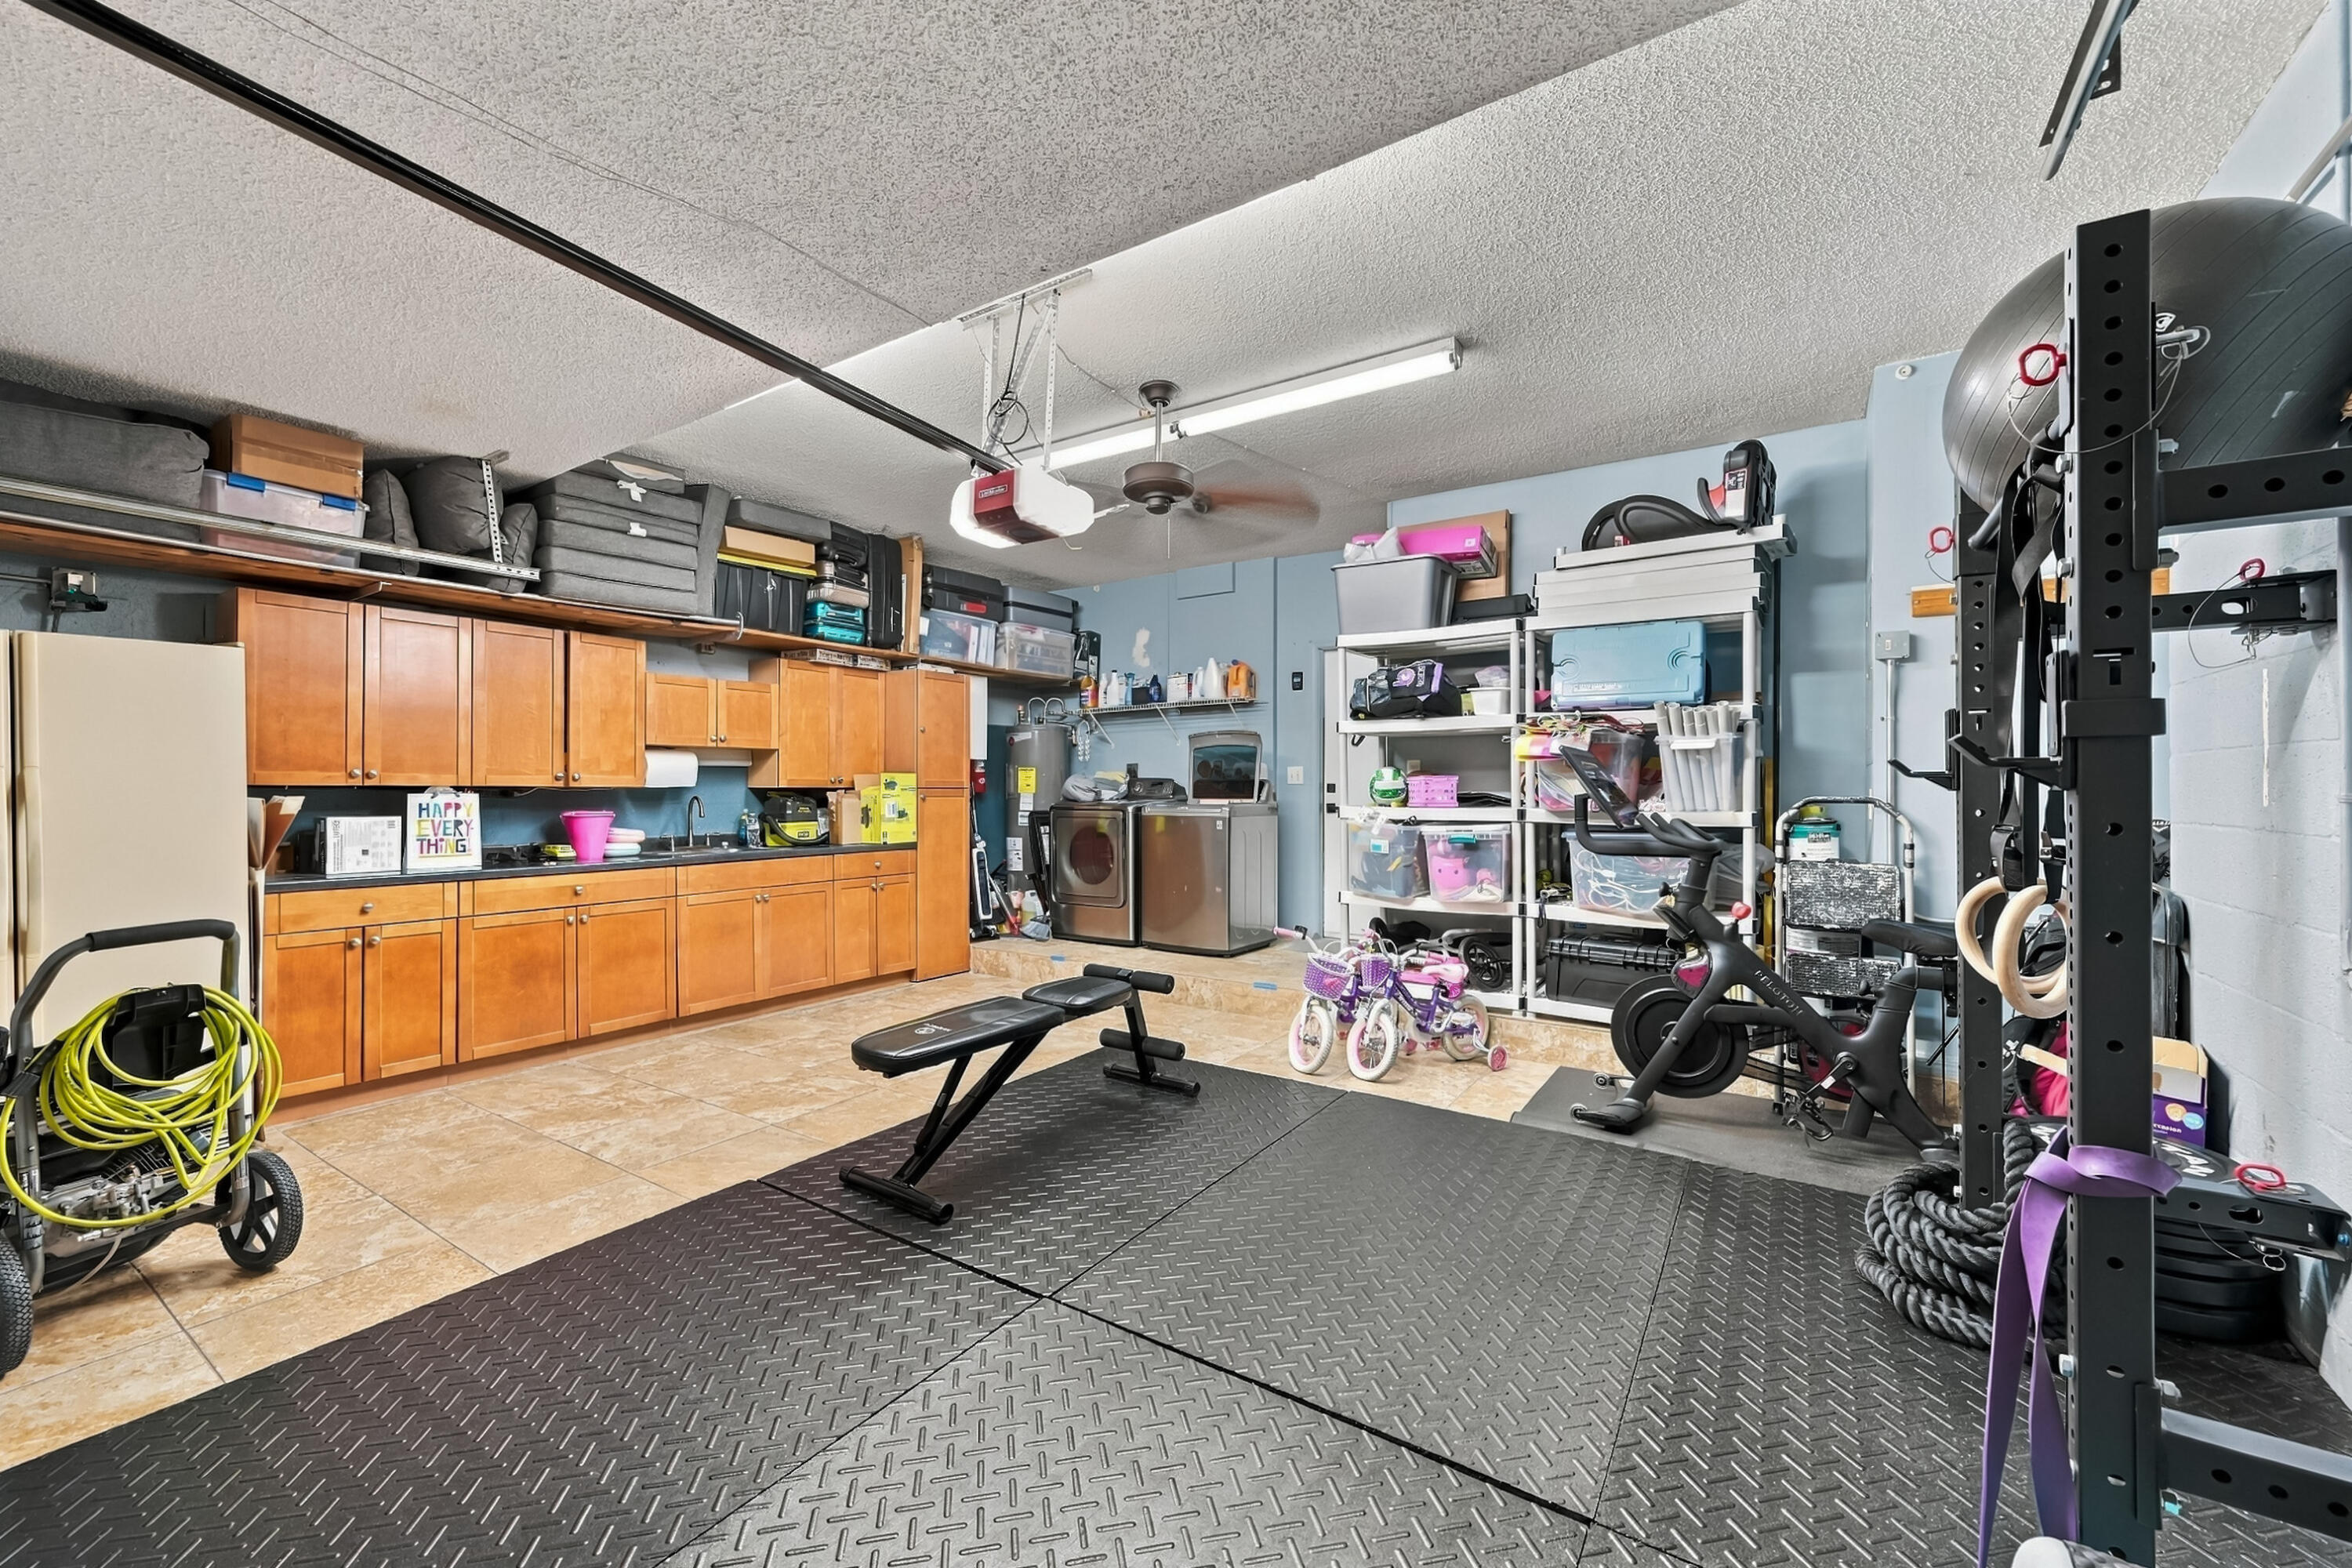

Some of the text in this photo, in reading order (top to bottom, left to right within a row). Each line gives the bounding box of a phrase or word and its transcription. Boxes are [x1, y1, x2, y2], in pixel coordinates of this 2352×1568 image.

[418, 803, 473, 818] HAPPY
[1755, 970, 1803, 1016] PELOTON
[2153, 1123, 2182, 1134] ccasion
